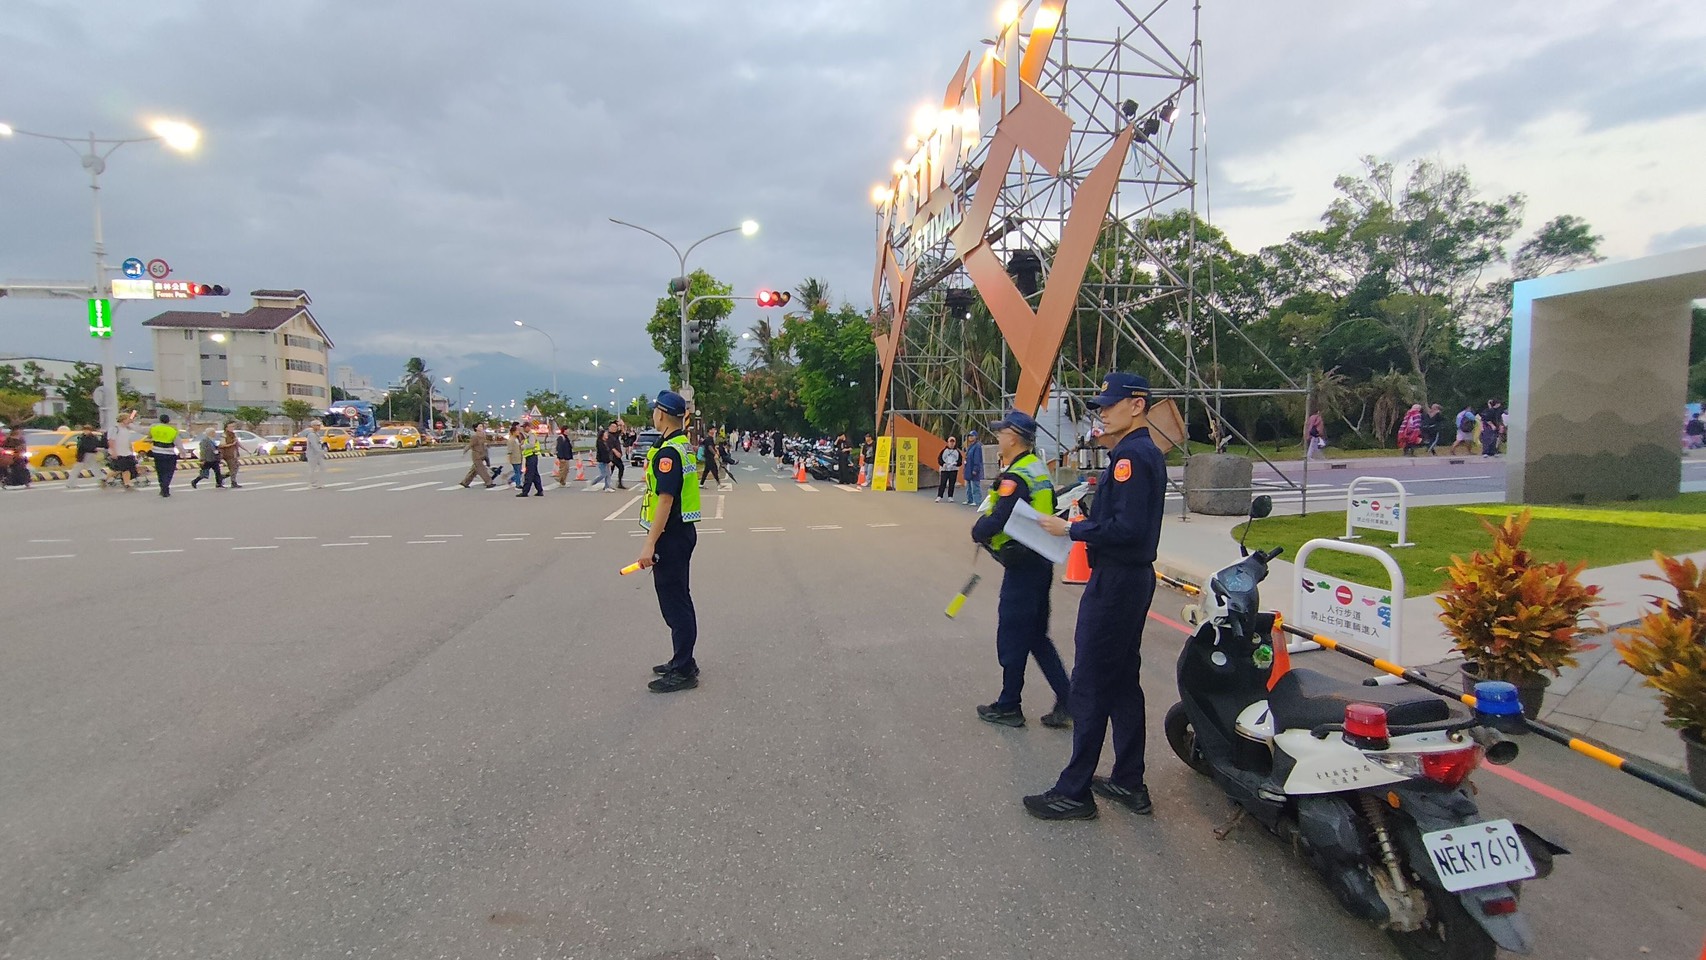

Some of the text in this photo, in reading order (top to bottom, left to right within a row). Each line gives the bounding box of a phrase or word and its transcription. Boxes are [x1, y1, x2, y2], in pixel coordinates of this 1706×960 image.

[152, 265, 165, 273] 60
[1327, 604, 1362, 620] 人行步道
[1310, 610, 1380, 638] 禁止任何車輛進入
